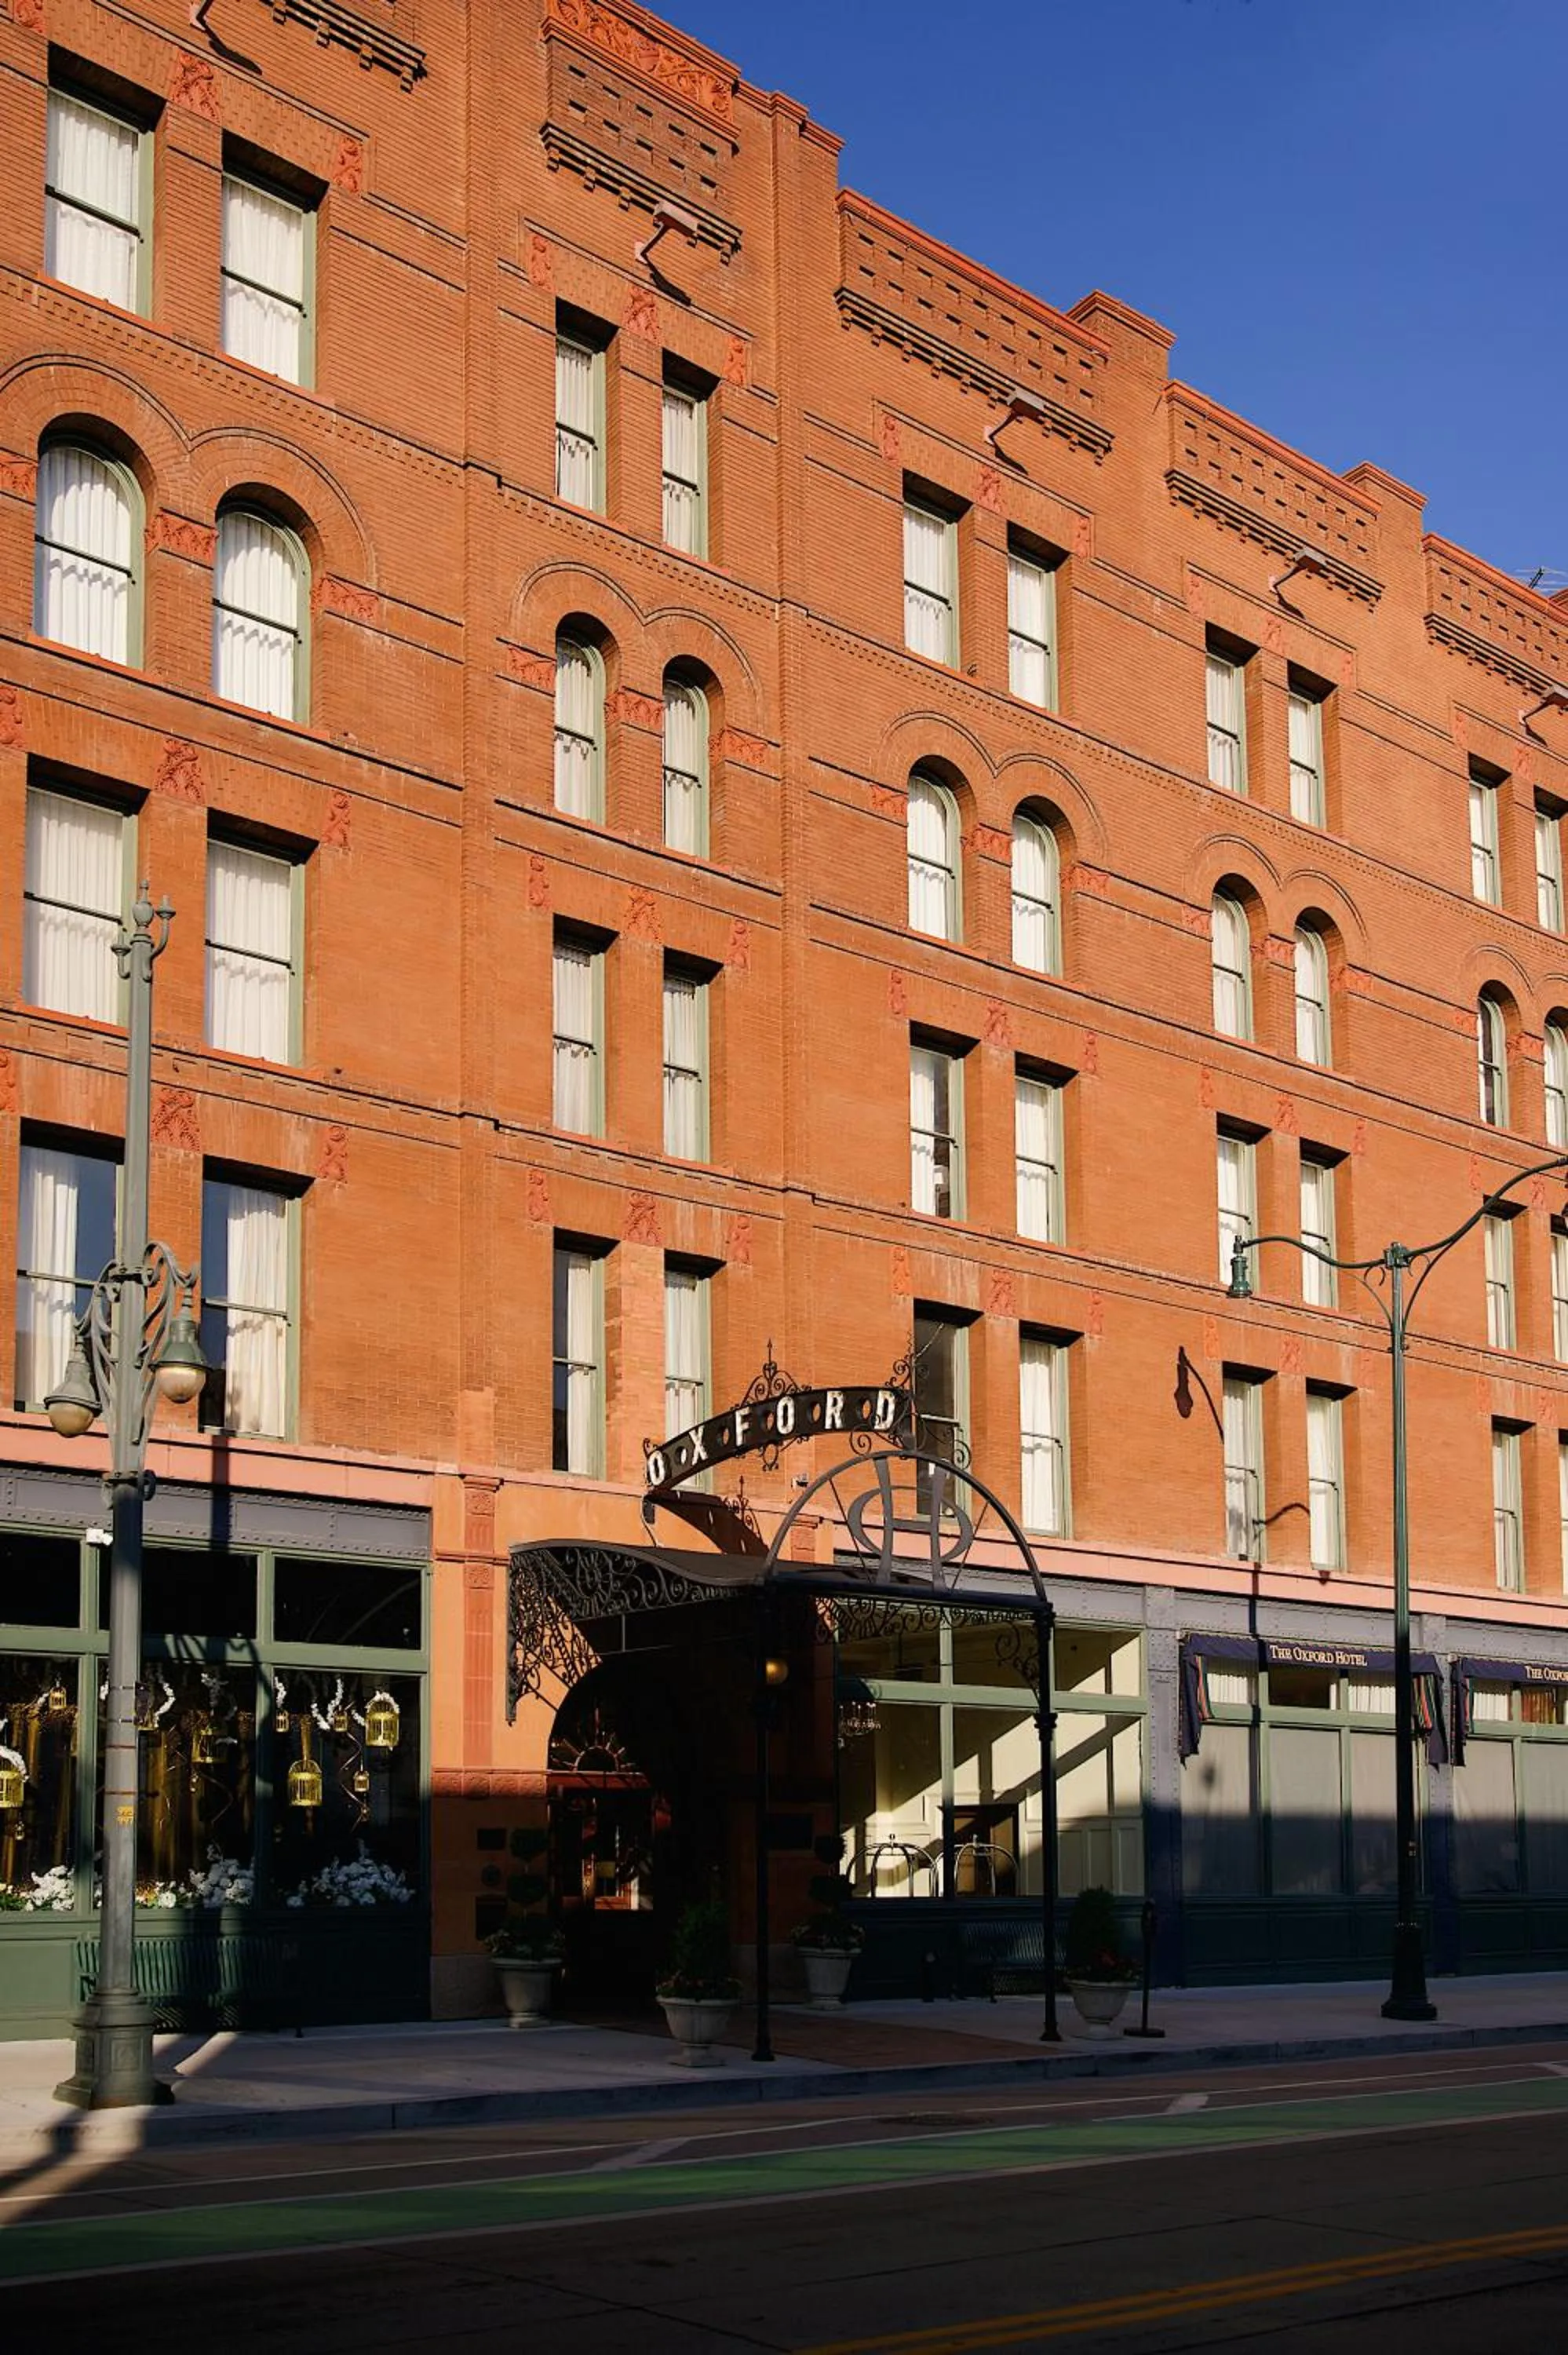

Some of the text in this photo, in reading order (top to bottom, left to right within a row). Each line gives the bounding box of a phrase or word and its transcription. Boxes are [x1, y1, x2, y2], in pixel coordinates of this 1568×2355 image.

[647, 1390, 895, 1486] OXFORD
[1293, 1647, 1333, 1663] OXFORD
[1335, 1651, 1368, 1667] HOTEL
